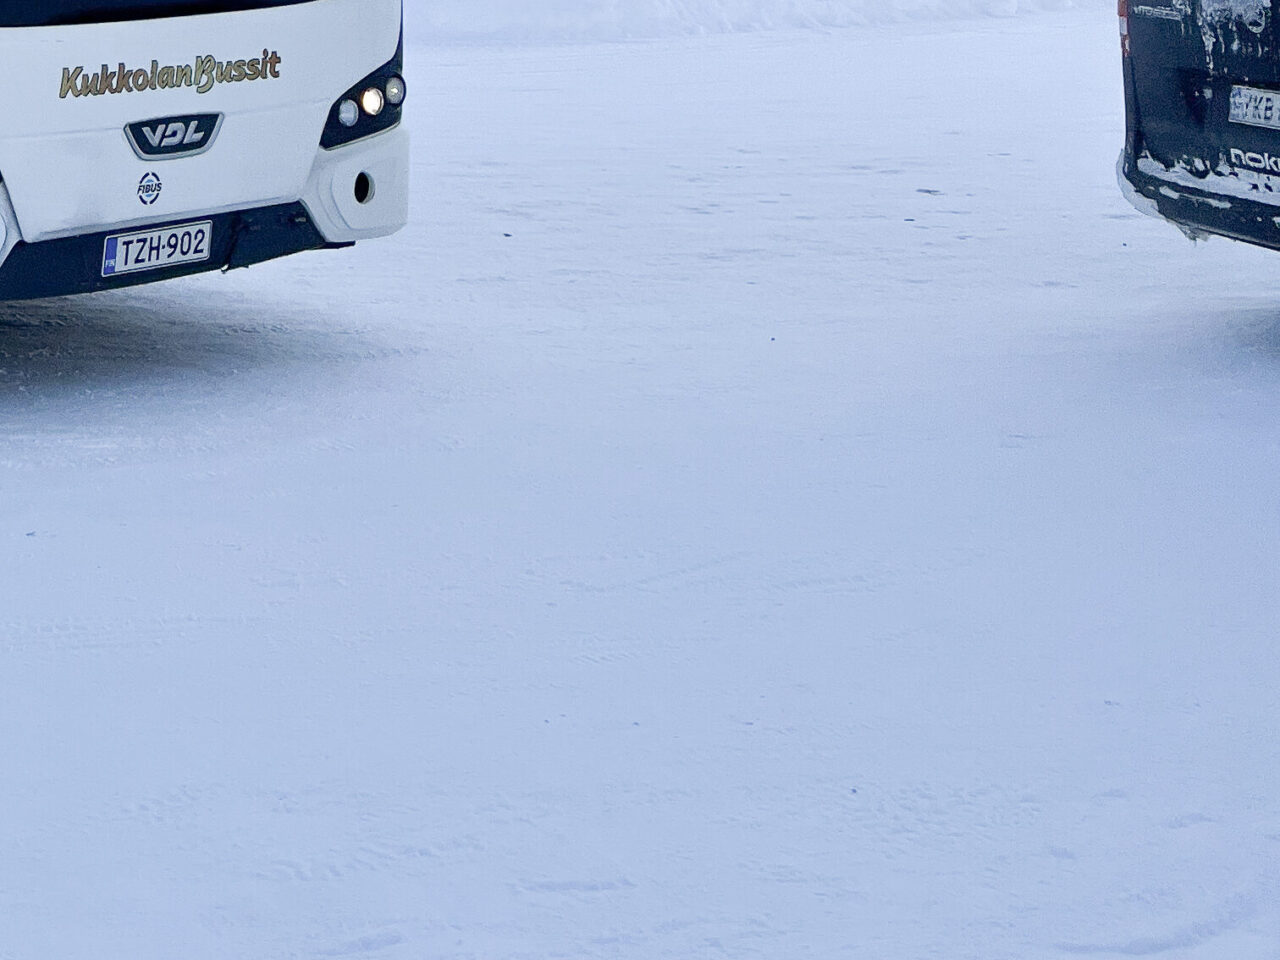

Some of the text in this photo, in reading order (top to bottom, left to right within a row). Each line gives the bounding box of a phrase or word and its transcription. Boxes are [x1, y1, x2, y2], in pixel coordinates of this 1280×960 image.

[142, 120, 205, 147] VDL
[137, 182, 162, 195] FIBUS
[122, 228, 206, 266] TZH-902
